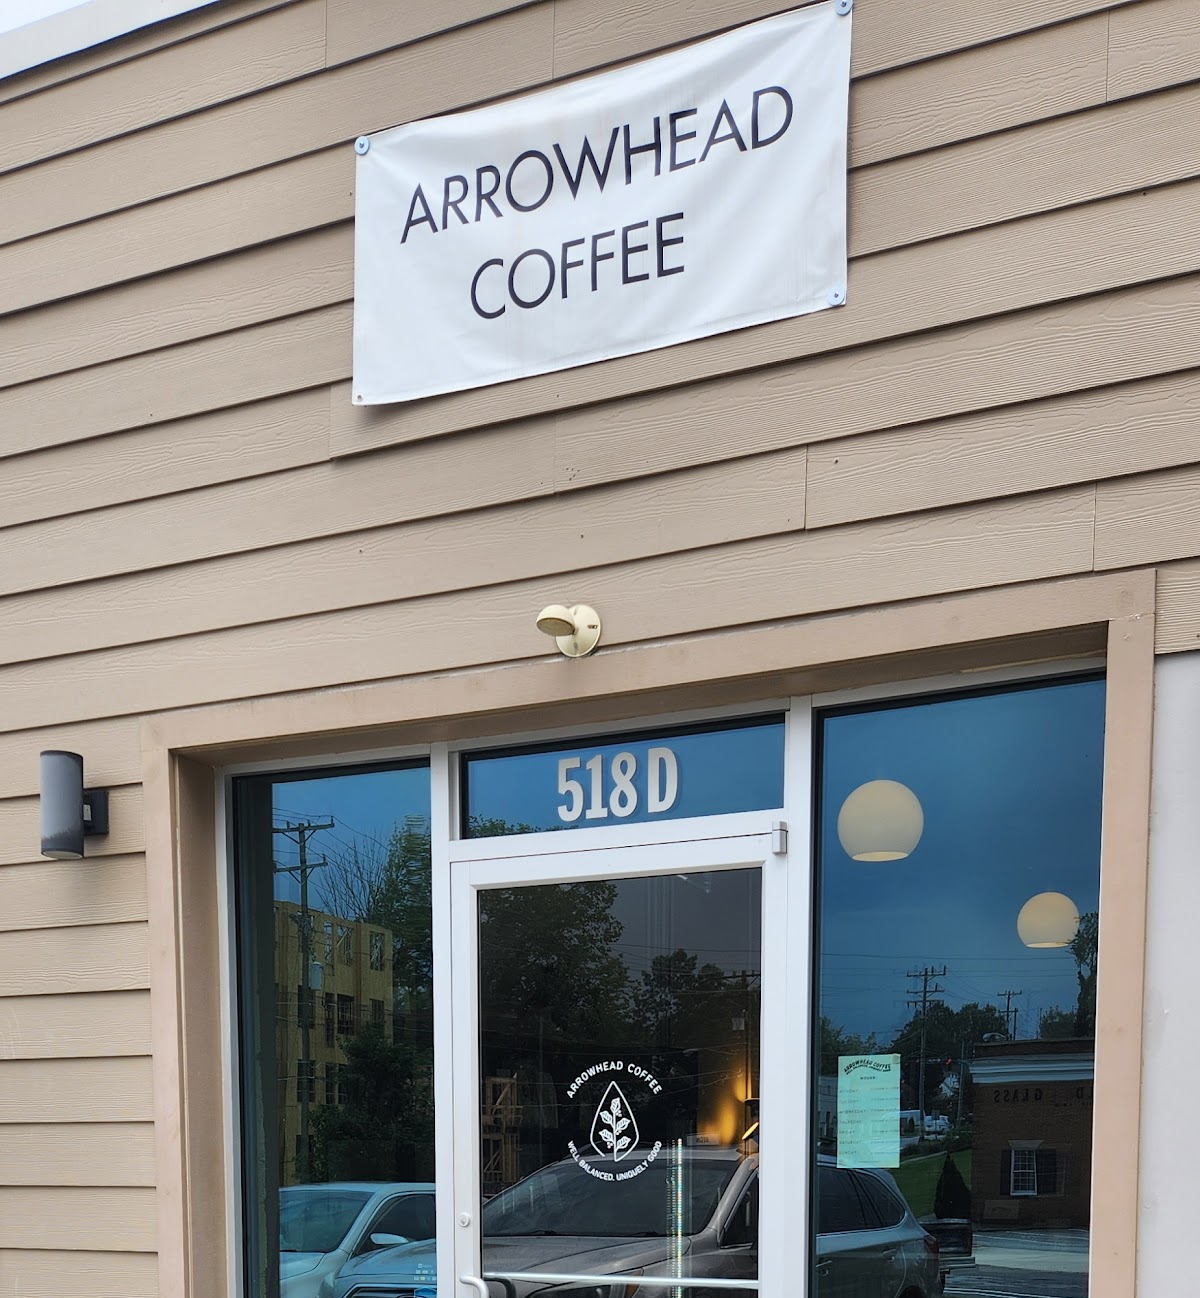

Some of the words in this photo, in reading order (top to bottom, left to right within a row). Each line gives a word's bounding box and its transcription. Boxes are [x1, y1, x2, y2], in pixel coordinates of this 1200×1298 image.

[400, 85, 794, 245] ARROWHEAD
[470, 211, 686, 320] COFFEE
[557, 751, 638, 822] 518
[647, 746, 679, 813] D
[566, 1060, 624, 1099] ARROWHEAD
[627, 1062, 663, 1095] COFFEE
[567, 1140, 580, 1162] WELL
[578, 1159, 615, 1181] BALANCED.
[616, 1160, 649, 1181] UNIQUELY
[647, 1140, 663, 1163] GOOD
